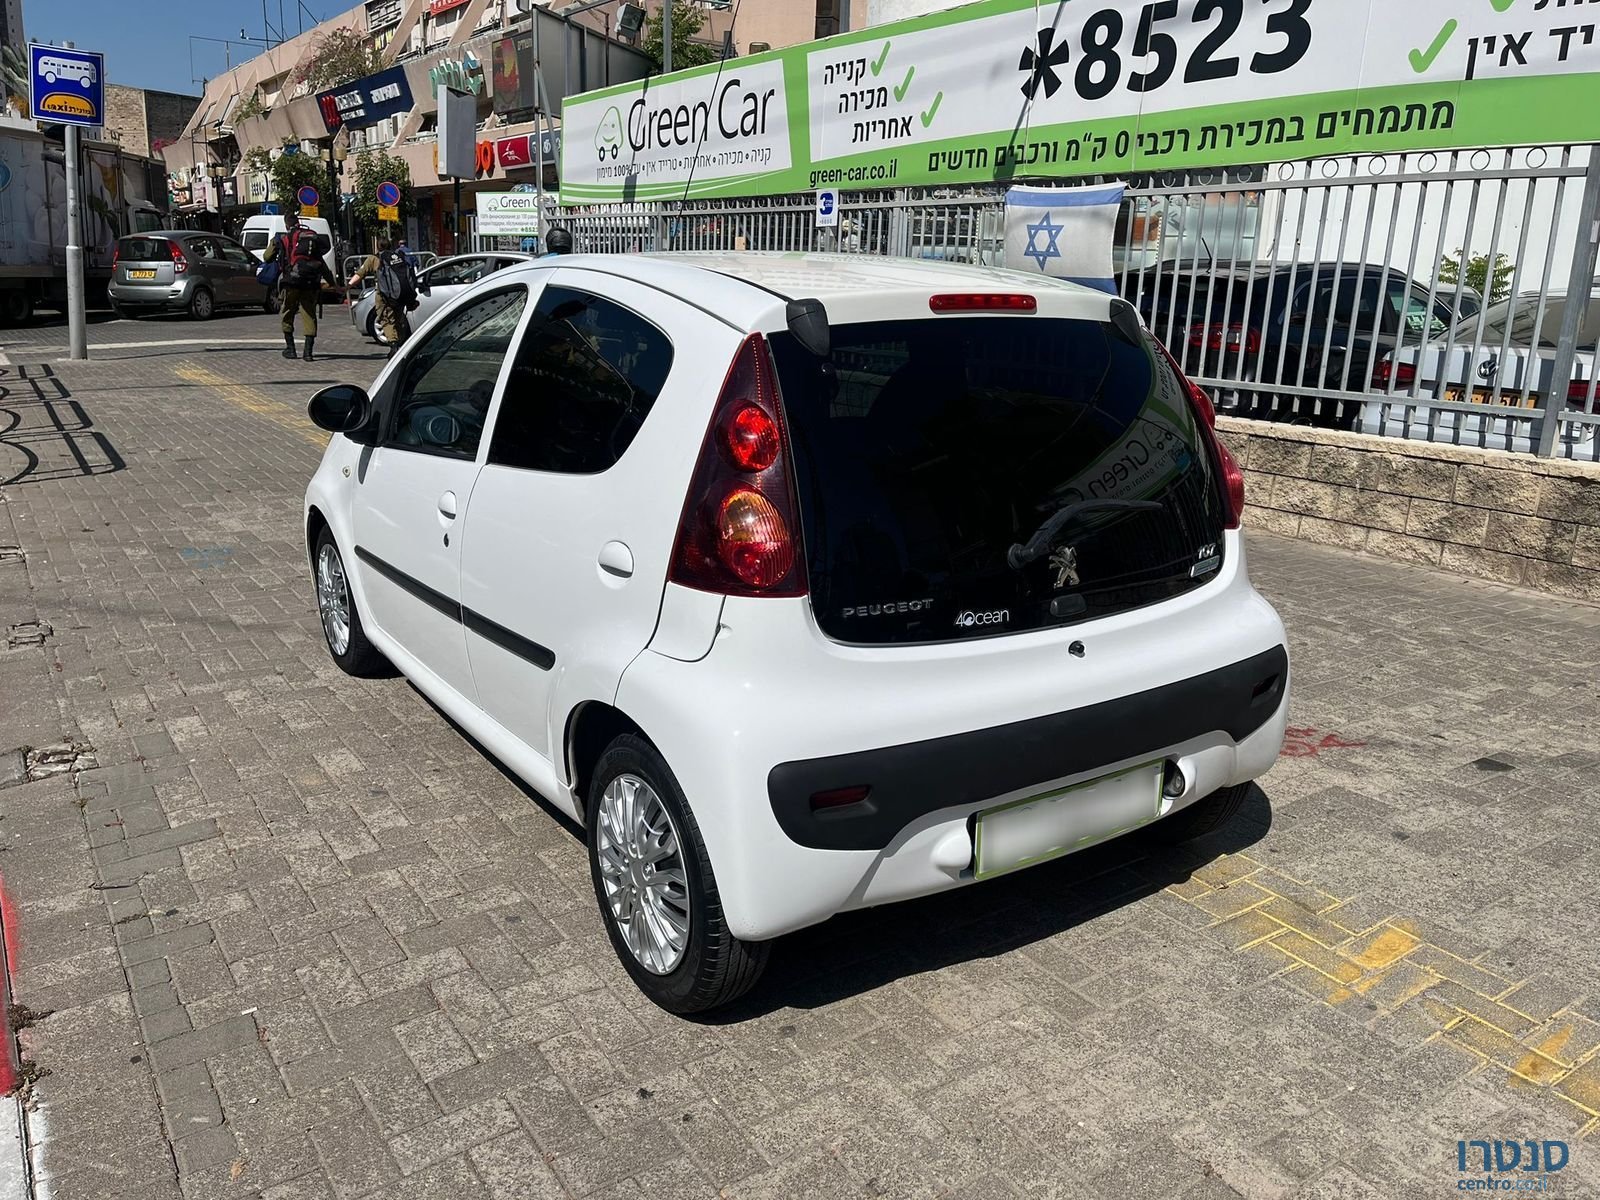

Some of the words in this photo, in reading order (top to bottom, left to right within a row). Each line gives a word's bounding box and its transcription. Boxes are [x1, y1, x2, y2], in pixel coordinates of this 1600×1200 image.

[1464, 31, 1534, 81] אין
[823, 57, 867, 86] קנייה
[838, 86, 888, 114] מכירה
[627, 98, 709, 152] Green
[717, 78, 776, 140] Car
[1315, 100, 1455, 140] מתמחים
[852, 115, 914, 144] אחריות
[1136, 127, 1191, 157] רכבי
[1196, 115, 1305, 151] במכירת
[751, 147, 772, 166] קניה
[994, 140, 1060, 168] ורכבים
[1114, 130, 1130, 158] 0
[614, 164, 632, 177] 100%
[646, 161, 657, 177] אין
[658, 158, 678, 172] טרייד
[683, 154, 712, 170] אחריות
[717, 150, 744, 167] מכירה
[927, 147, 989, 172] חדשים
[596, 166, 612, 183] מימון
[809, 158, 898, 188] green-car.co.il
[500, 195, 531, 208] Green
[842, 598, 935, 618] PEUGEOT
[955, 608, 1011, 628] 4Ocean
